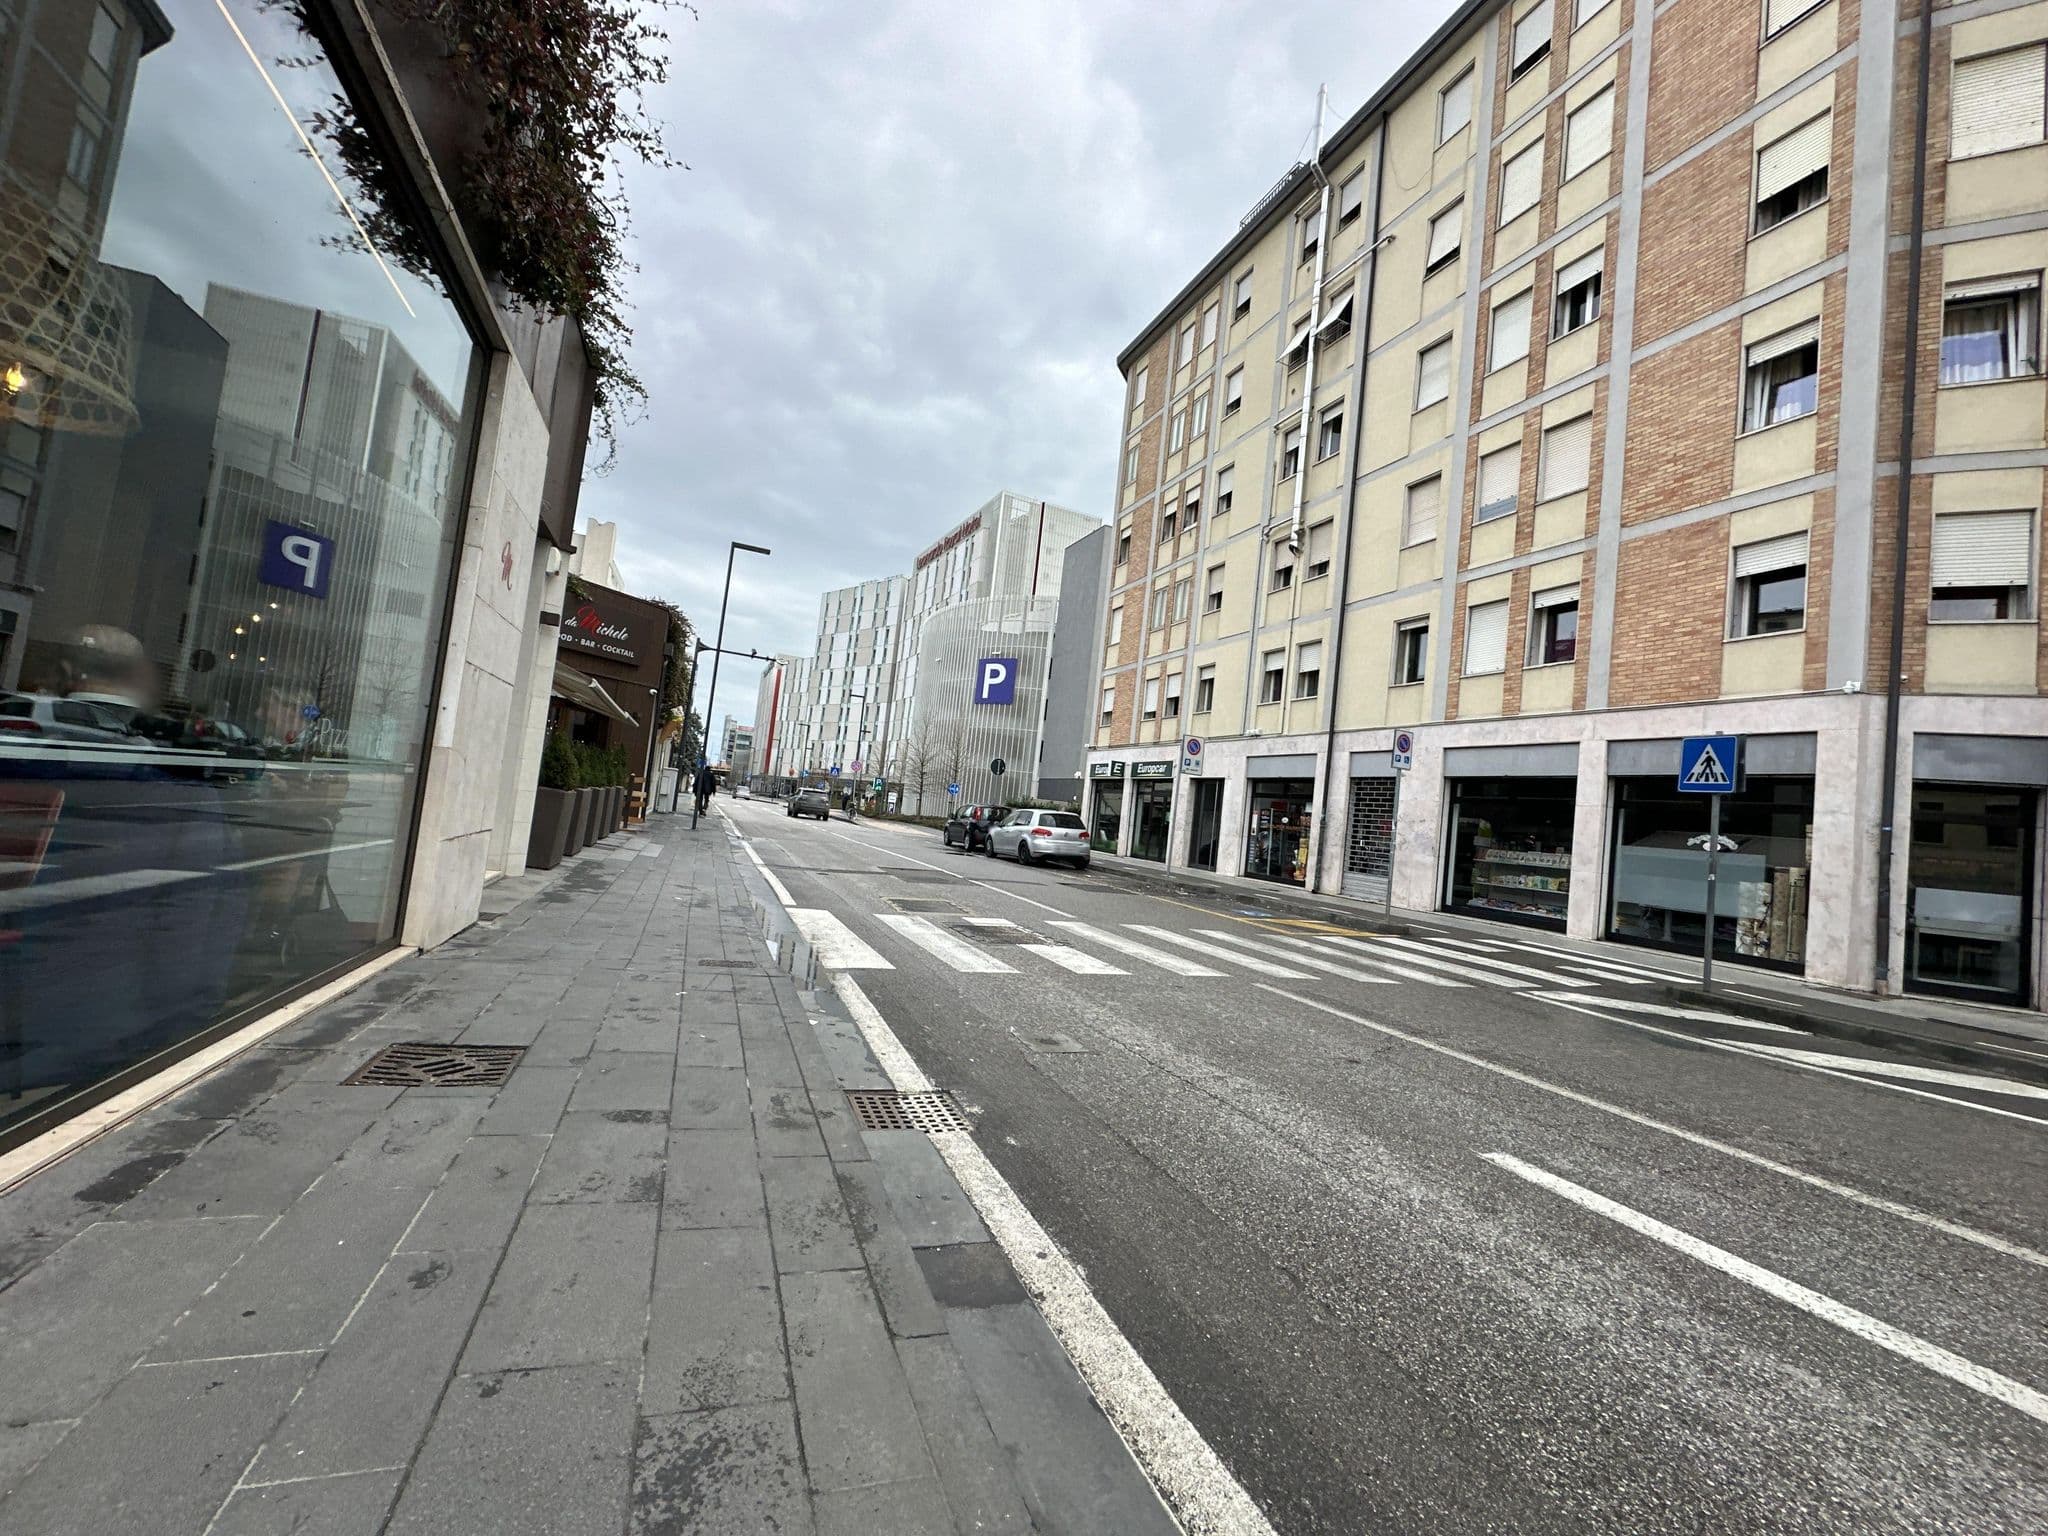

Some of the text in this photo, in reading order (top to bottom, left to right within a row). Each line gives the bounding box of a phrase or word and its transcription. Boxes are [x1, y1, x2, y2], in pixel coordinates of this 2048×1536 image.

[577, 605, 630, 641] Michele
[580, 638, 596, 648] BAR
[602, 644, 635, 658] COCKTAIL
[982, 663, 1007, 699] P
[1113, 763, 1123, 773] E
[1137, 763, 1167, 774] Europcar
